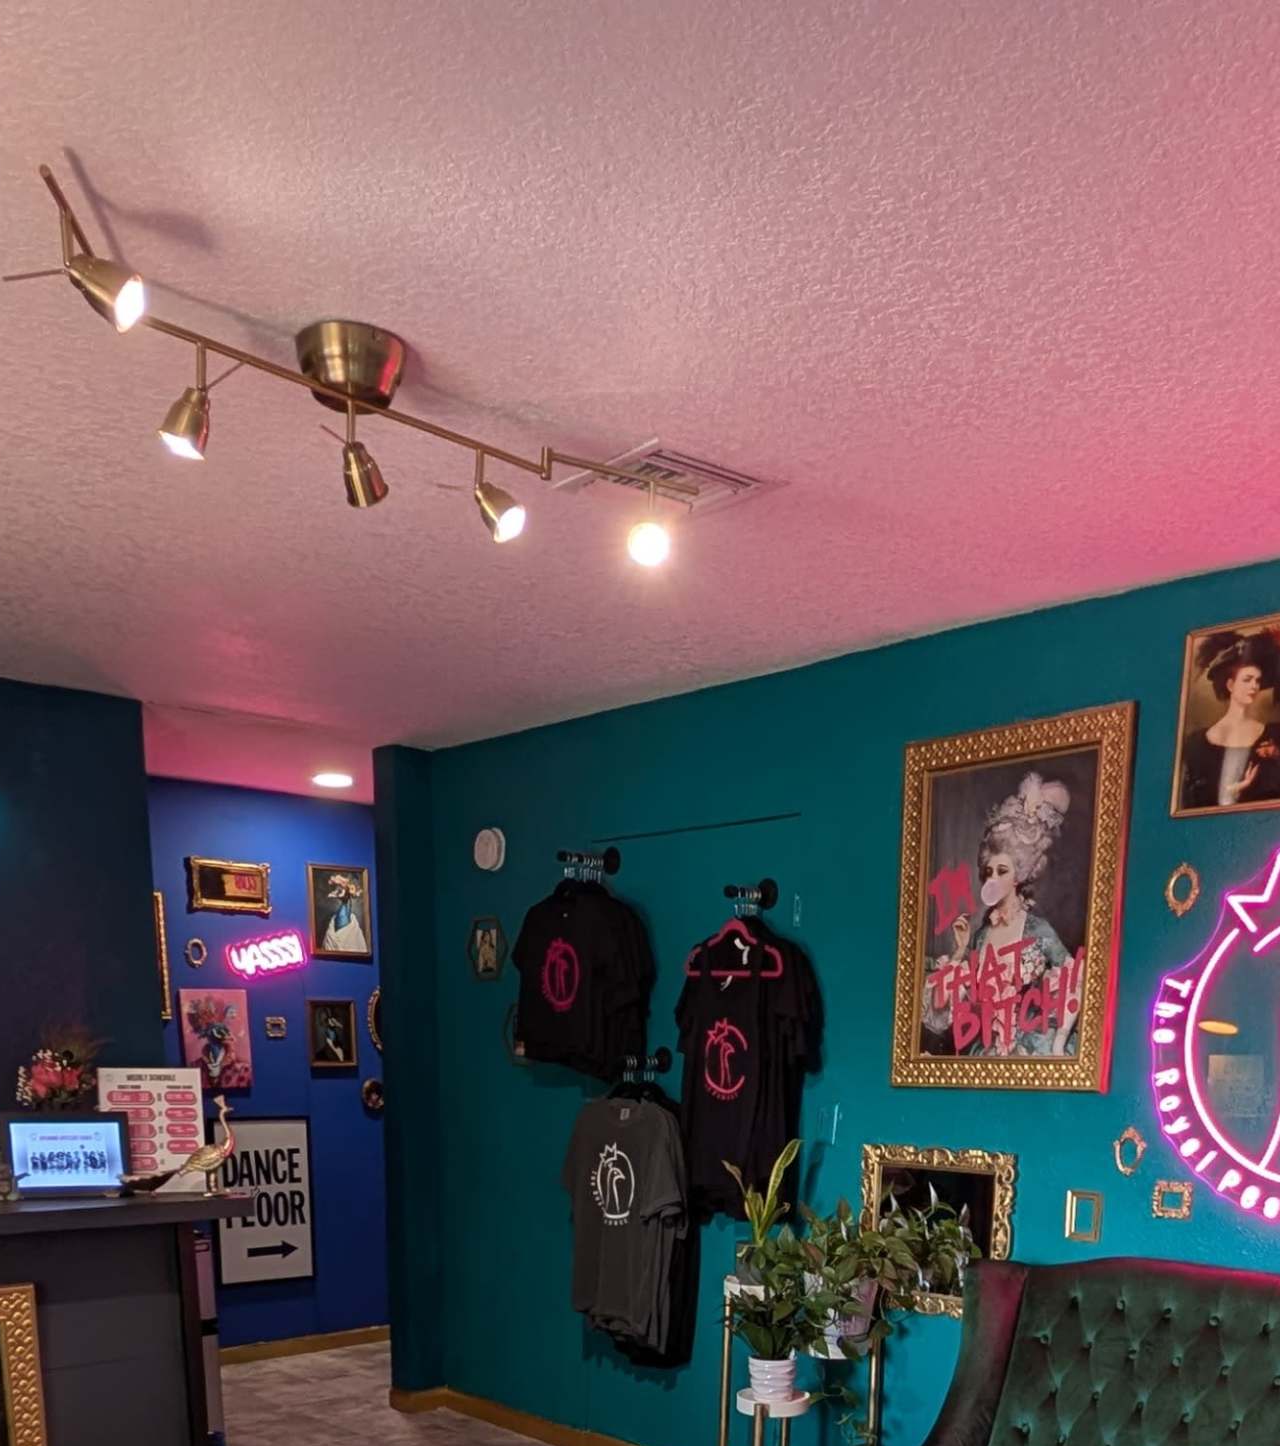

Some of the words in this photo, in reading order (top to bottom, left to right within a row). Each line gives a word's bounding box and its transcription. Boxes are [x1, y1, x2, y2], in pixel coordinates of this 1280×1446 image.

[928, 936, 1037, 1010] THAT
[951, 946, 1087, 1056] BITCH!
[222, 1147, 302, 1188] DANCE
